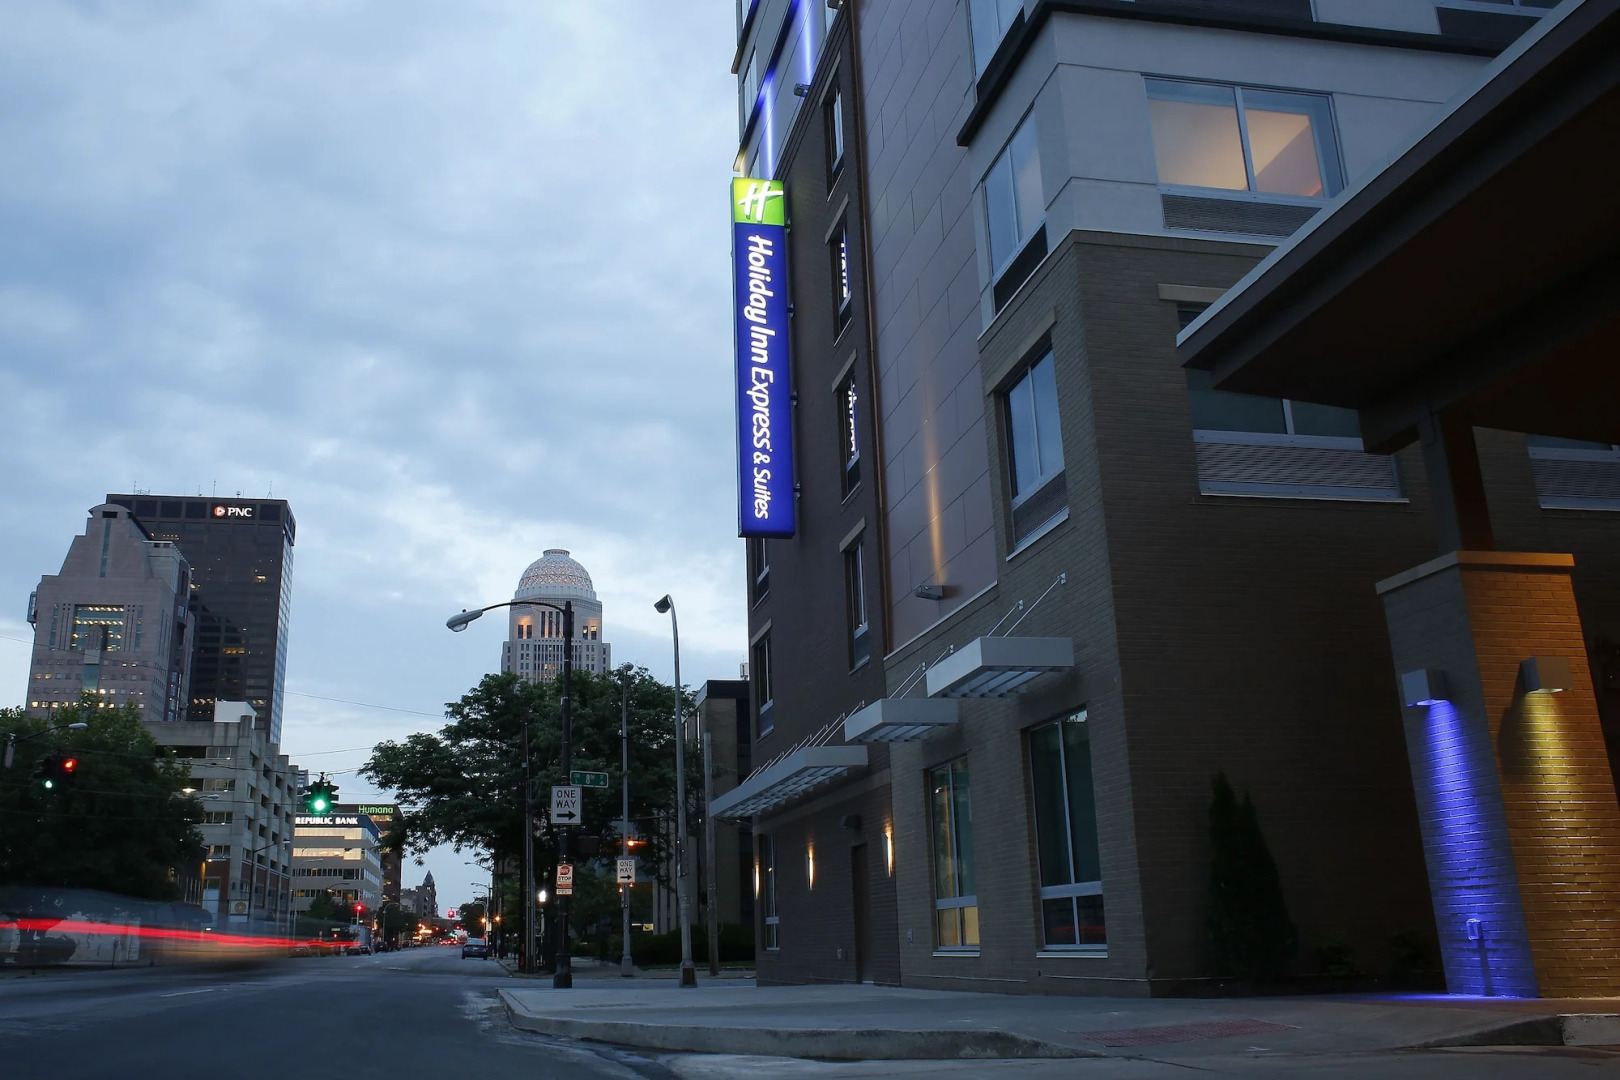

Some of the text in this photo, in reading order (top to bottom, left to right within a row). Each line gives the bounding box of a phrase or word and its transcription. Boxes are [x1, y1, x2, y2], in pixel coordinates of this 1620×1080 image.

[744, 234, 776, 520] Holiday Inn Express & Suites
[227, 507, 253, 517] PNC
[556, 789, 576, 799] ONE
[556, 800, 577, 809] WAY
[358, 805, 394, 814] Humana
[295, 817, 359, 825] REPUBLIC BANK
